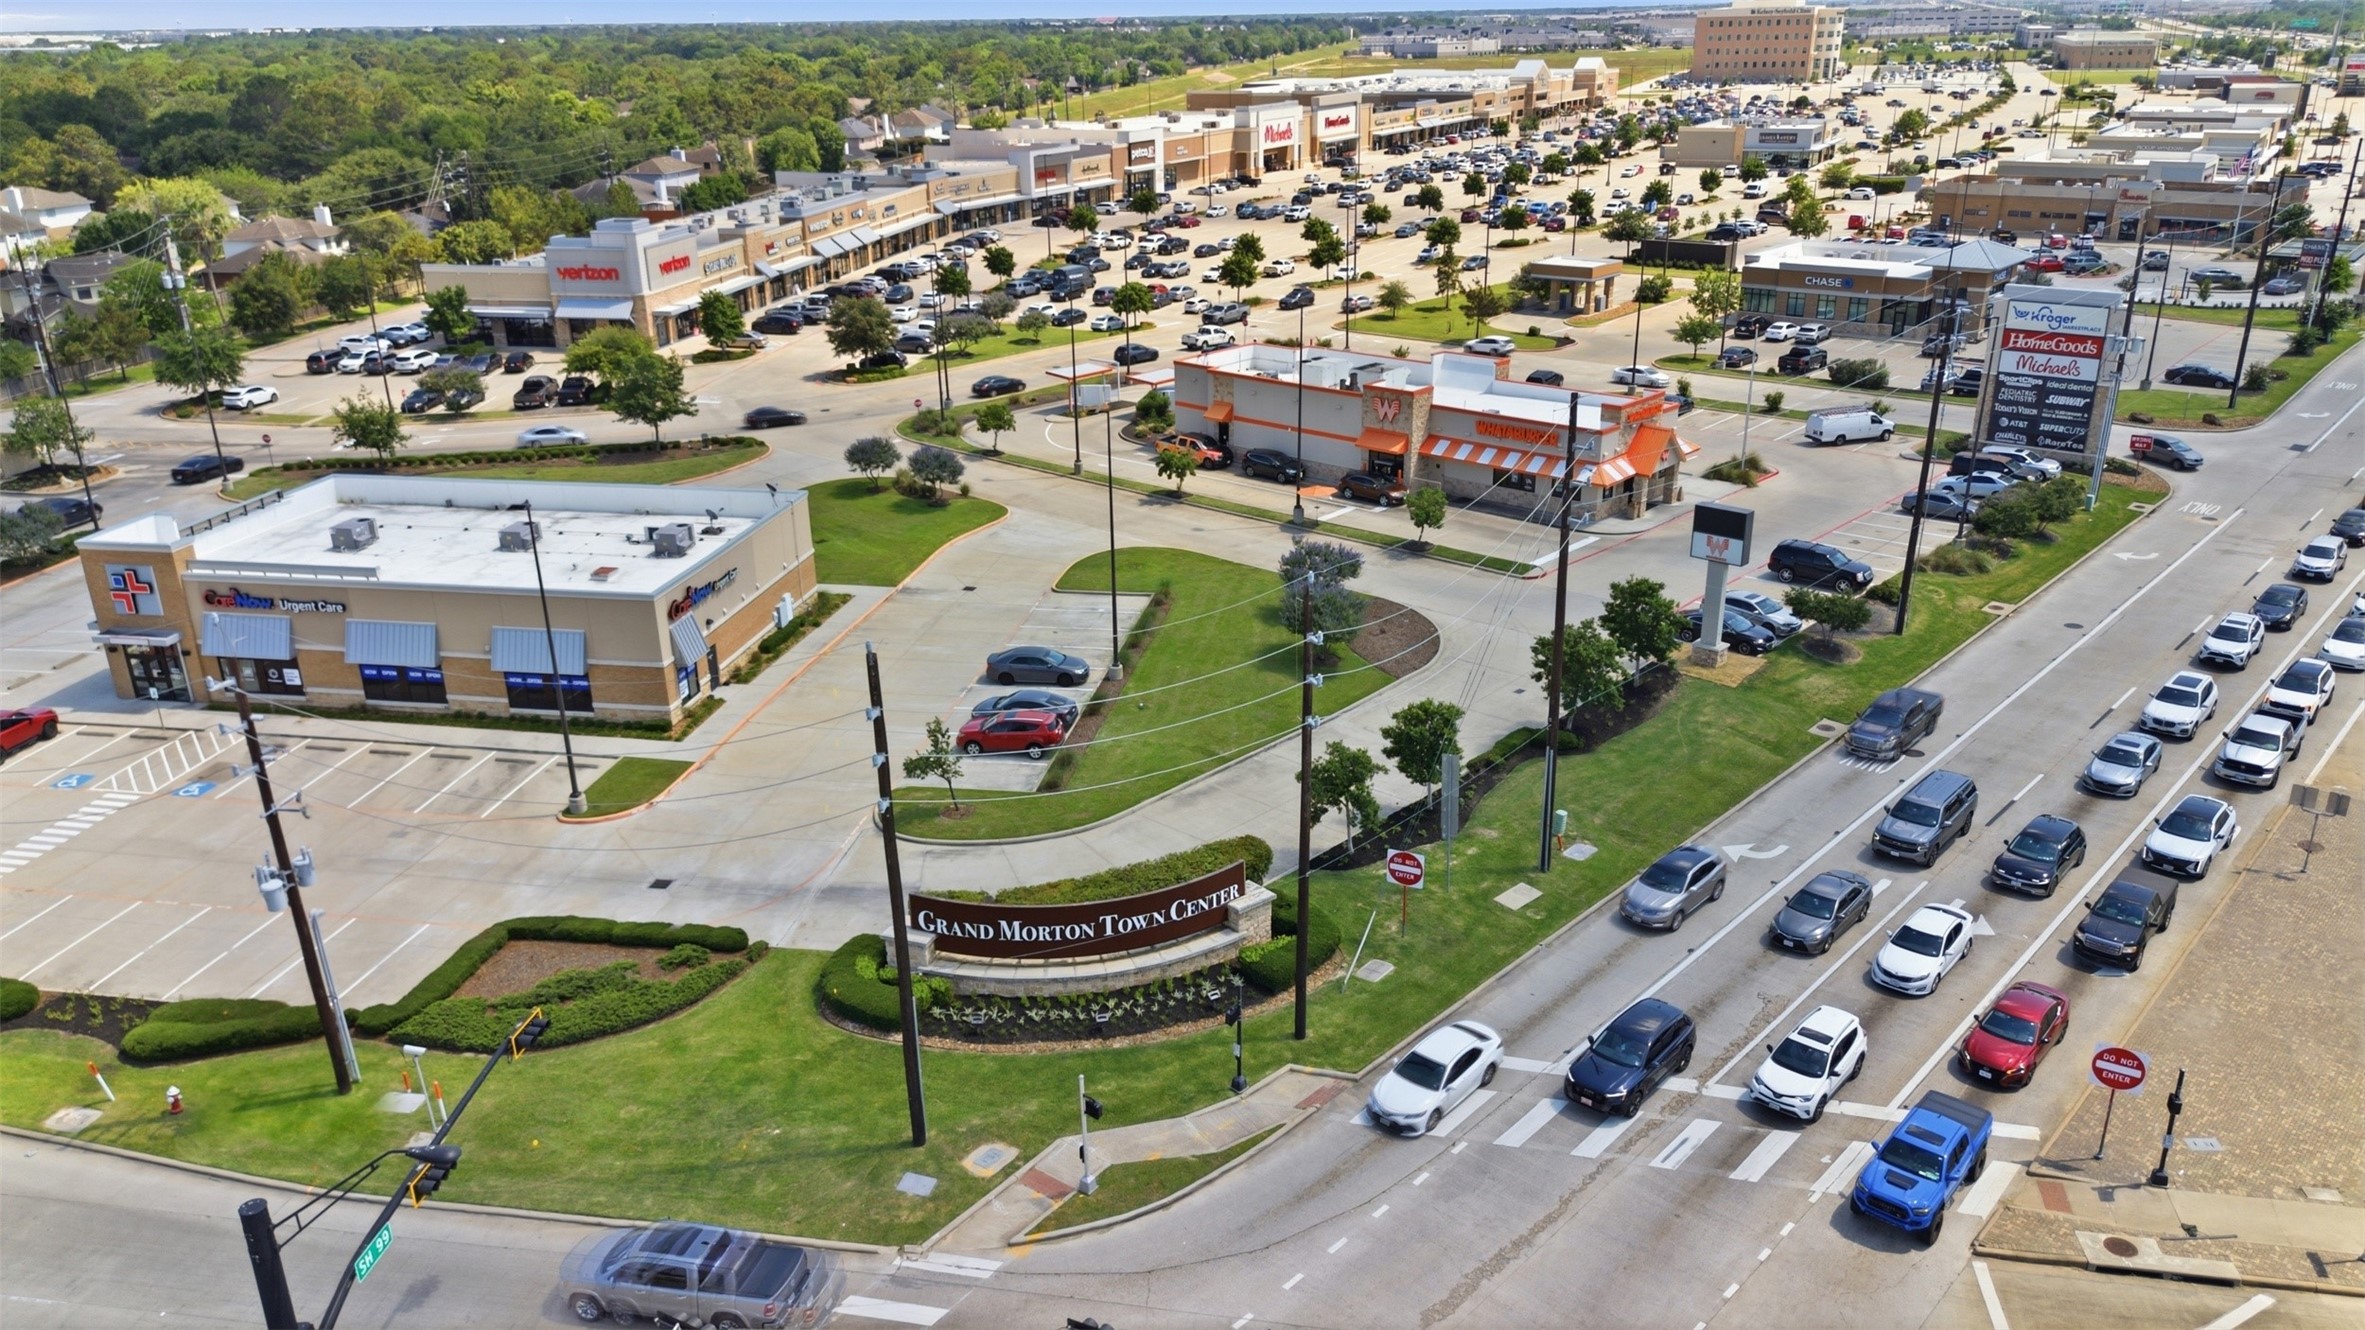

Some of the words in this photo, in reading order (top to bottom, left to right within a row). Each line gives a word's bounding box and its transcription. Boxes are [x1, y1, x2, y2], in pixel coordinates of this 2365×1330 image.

[1264, 121, 1293, 144] Michaels
[556, 263, 619, 281] verizon
[659, 255, 690, 275] verizon
[1805, 276, 1842, 288] CHASE
[2031, 306, 2077, 330] Kroger
[2008, 333, 2098, 355] HomeGoods
[2016, 354, 2081, 377] Michaels
[2001, 387, 2037, 397] PEDIATRIC
[2046, 381, 2067, 389] ideal
[2067, 383, 2094, 392] dental
[1998, 393, 2037, 403] DENTISTRY
[2045, 394, 2090, 407] SUBWAY
[2009, 419, 2028, 428] AT&T
[2039, 423, 2086, 435] SUPERCUTS
[1476, 420, 1559, 447] WHATABURGER
[2177, 501, 2221, 515] ONLY
[279, 599, 316, 613] Urgent
[318, 601, 345, 613] Care
[1395, 871, 1415, 880] ENTER
[917, 910, 994, 940] GRAND
[998, 920, 1095, 942] MORTON
[1099, 908, 1166, 937] TOWN
[1169, 883, 1239, 922] CENTER
[2103, 1053, 2116, 1062] DO
[2120, 1057, 2139, 1068] NOT
[2102, 1070, 2131, 1084] ENTER
[358, 1249, 374, 1276] SH
[376, 1230, 390, 1253] 99
